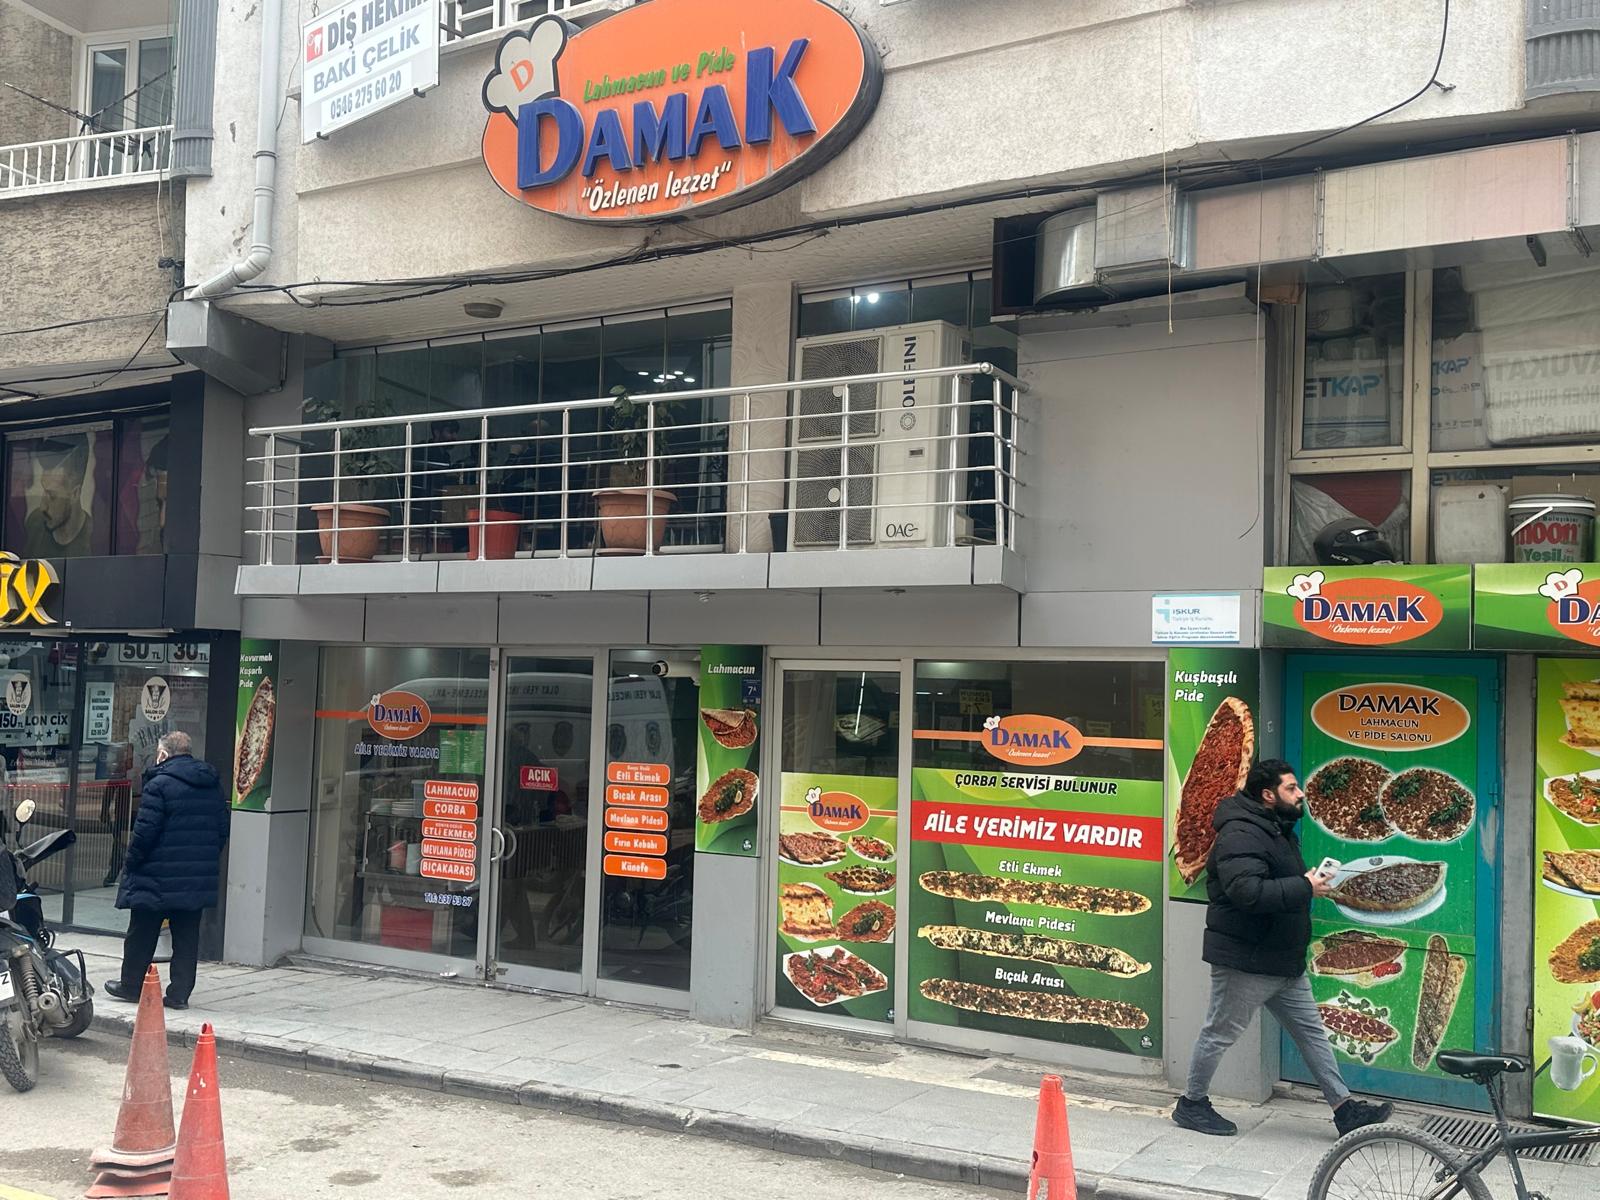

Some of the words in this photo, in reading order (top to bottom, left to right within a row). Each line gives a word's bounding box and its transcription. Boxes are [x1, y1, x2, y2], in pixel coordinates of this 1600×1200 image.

[328, 10, 357, 52] DİŞ
[362, 0, 428, 34] HEK
[313, 51, 356, 93] BAKİ
[362, 24, 420, 73] ÇELİK
[510, 59, 534, 92] D
[584, 75, 666, 103] Lahmacun
[672, 63, 691, 84] ve
[696, 46, 735, 78] Pide
[330, 92, 353, 120] 0546
[355, 84, 372, 110] 275
[375, 77, 386, 100] 60
[389, 70, 402, 94] 20
[517, 38, 818, 190] DAMAK
[1431, 356, 1469, 376] TKAP
[1300, 580, 1312, 592] D
[1554, 580, 1568, 592] D
[1303, 596, 1428, 624] DAMAK
[708, 664, 756, 674] Lahmacun
[240, 680, 254, 688] Pide
[1174, 670, 1238, 687] Kuşbaşılı
[1174, 689, 1204, 702] Pide
[1338, 694, 1440, 716] DAMAK
[25, 715, 48, 726] LON
[374, 704, 423, 723] DAMAK
[1360, 718, 1419, 728] LAHMACUN
[992, 727, 1072, 749] DAMAK
[1348, 730, 1360, 739] VE
[1364, 730, 1386, 740] PİDE
[1390, 733, 1432, 742] SALONU
[528, 769, 551, 783] AÇIK
[616, 771, 630, 781] Etli
[634, 772, 660, 782] Ekmek
[426, 785, 477, 798] LAHMACUN
[955, 774, 997, 789] ÇORBA
[1000, 776, 1051, 791] SERVİSİ
[1054, 780, 1118, 796] BULUNUR
[613, 790, 635, 802] Bıçak
[639, 791, 662, 802] Arası
[434, 804, 466, 816] ÇORBA
[811, 802, 862, 819] DAMAK
[610, 814, 639, 825] Mevlana
[642, 815, 663, 826] Pidesi
[443, 828, 474, 839] EKMEK
[924, 810, 969, 833] AİLE
[972, 815, 1057, 842] YERİMİZ
[1062, 823, 1143, 849] VARDIR
[424, 843, 453, 856] MEVLANA
[453, 845, 474, 859] PİDESİ
[614, 837, 630, 848] Fırın
[633, 838, 657, 849] Kebabı
[621, 861, 649, 872] Künefe
[998, 860, 1019, 873] Etli
[1023, 862, 1062, 877] Ekmek
[985, 910, 1034, 927] Mevlana
[1038, 916, 1076, 932] Pidesi
[995, 968, 1029, 984] Bıçak
[1031, 972, 1065, 988] Arası
